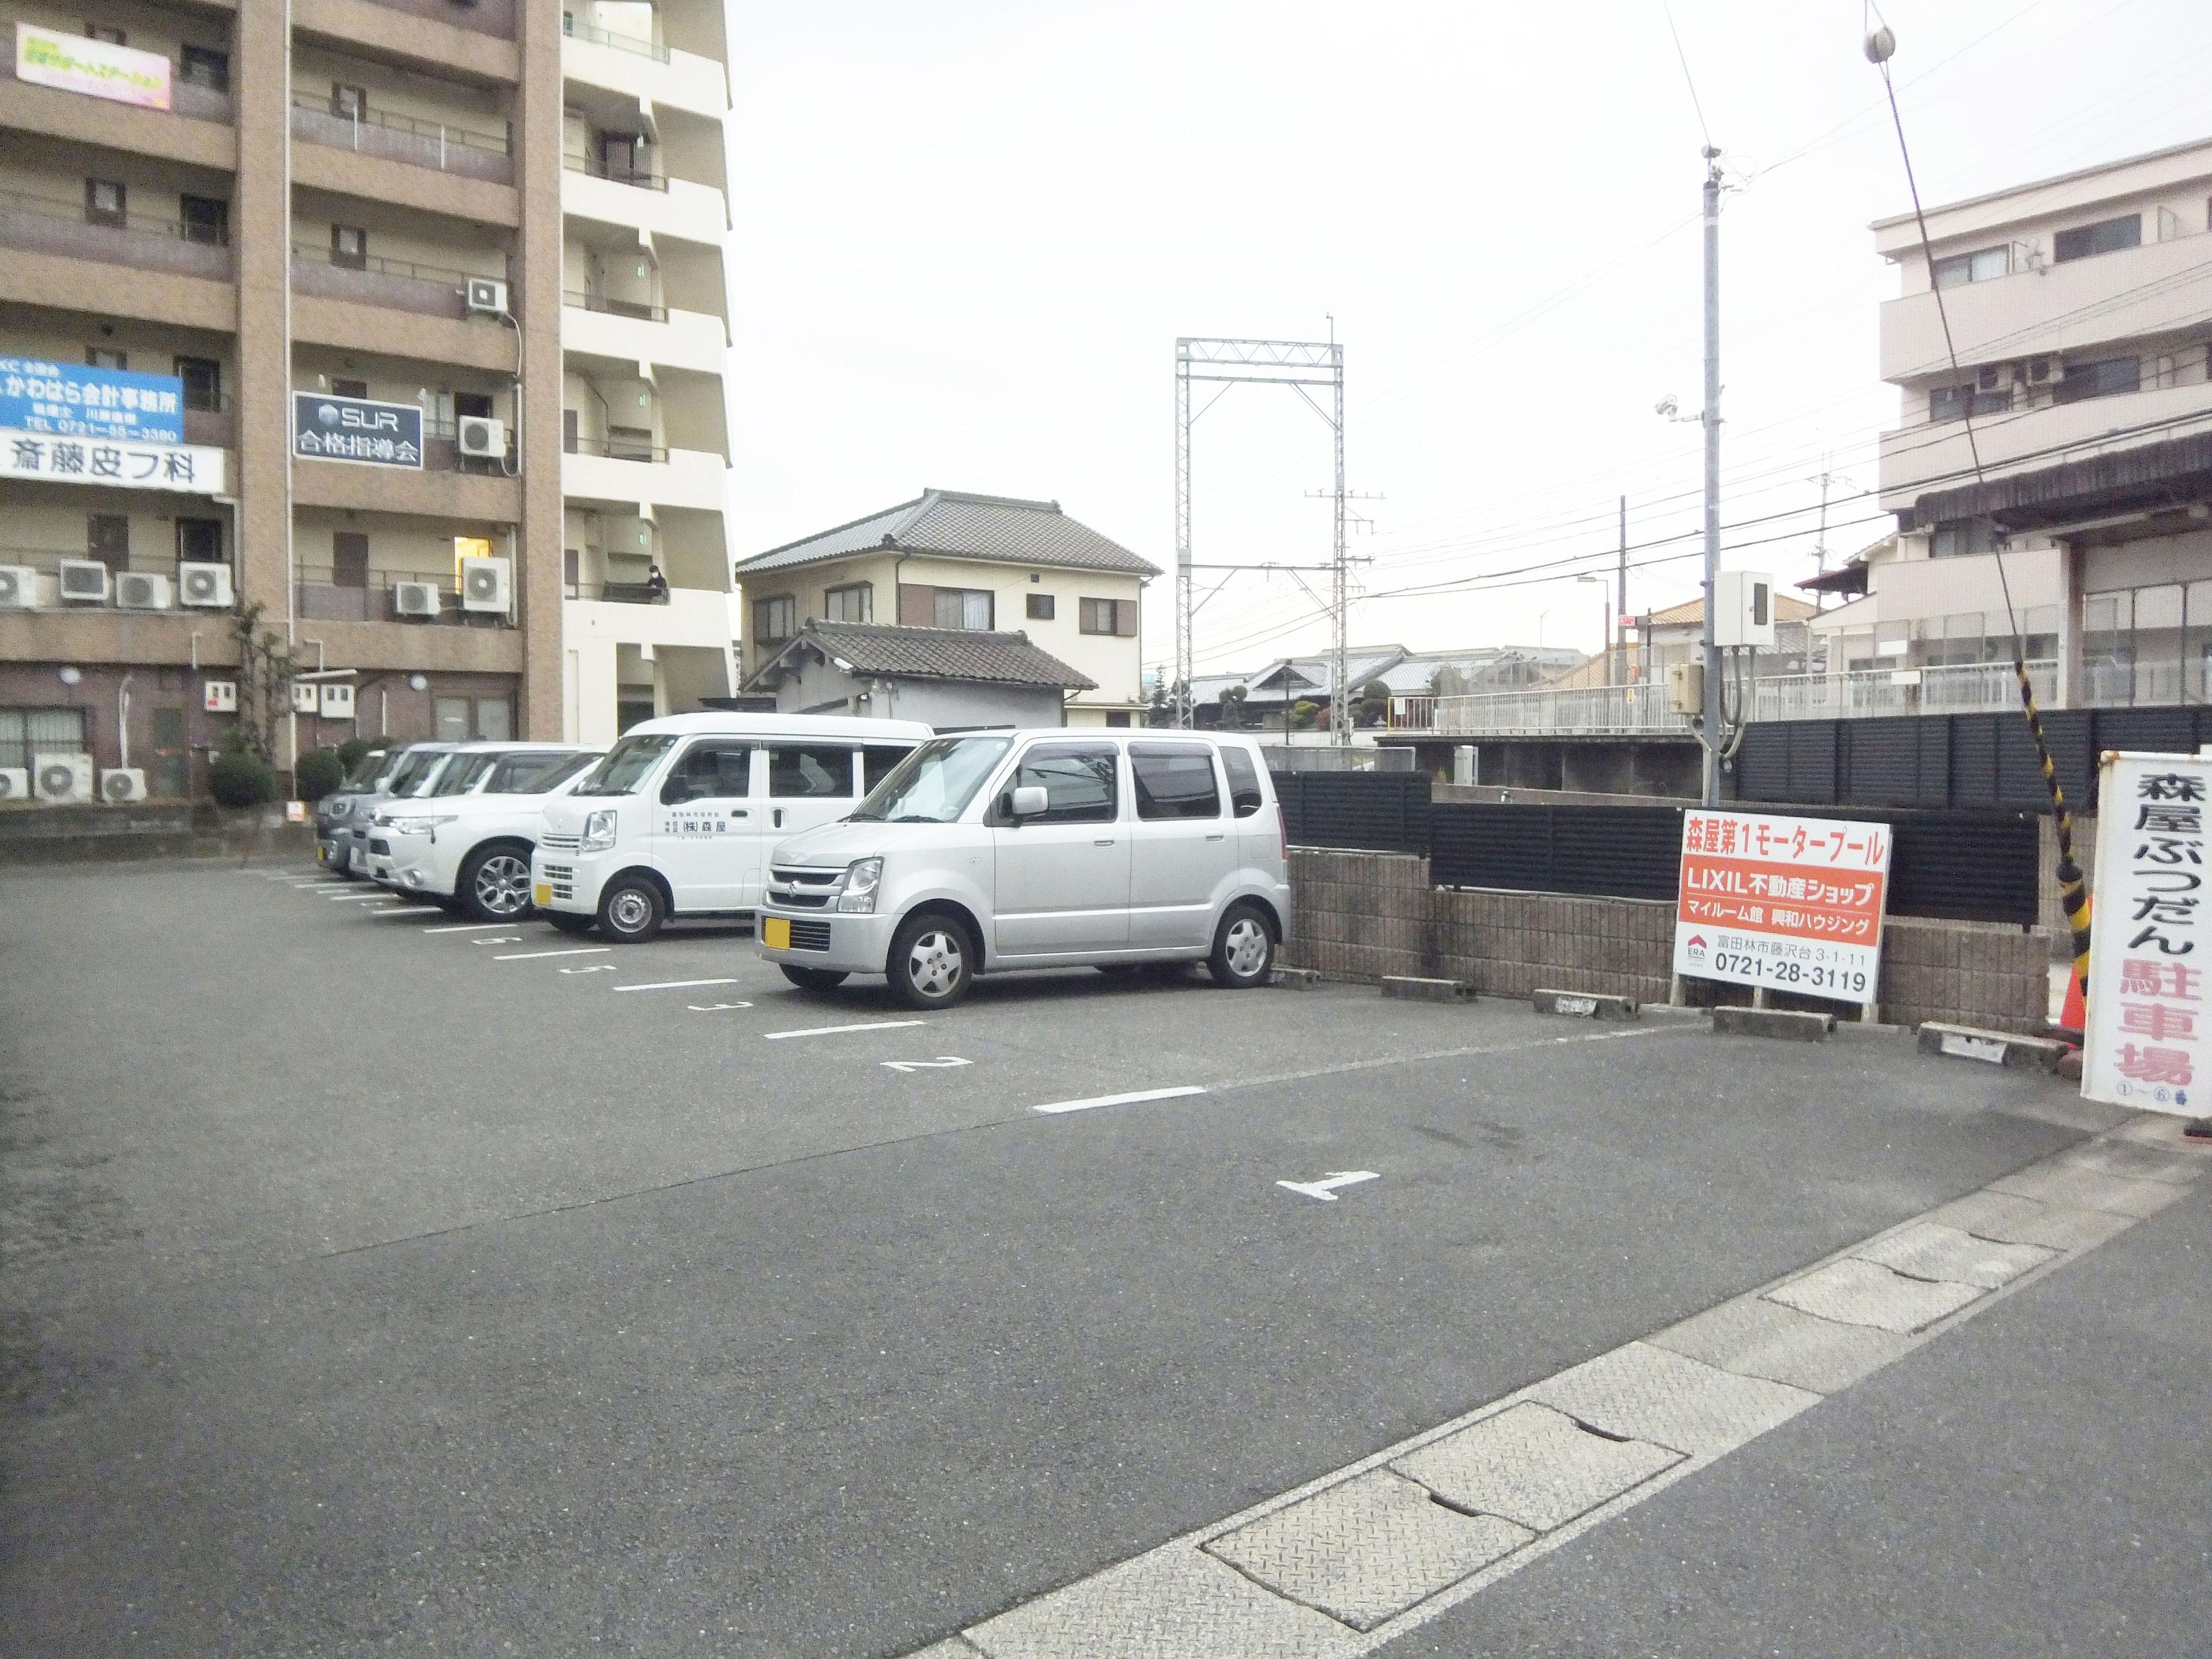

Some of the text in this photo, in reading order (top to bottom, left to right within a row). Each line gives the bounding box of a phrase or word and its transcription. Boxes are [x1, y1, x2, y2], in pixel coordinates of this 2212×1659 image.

[1686, 816, 1884, 865] 森屋第1モータープール
[1687, 867, 1874, 906] LIXIL不動産ショップ
[1687, 899, 1764, 925] マイルーム館
[1688, 948, 1705, 957] ERA
[1715, 952, 1866, 993] 0721-28-3119
[879, 1055, 975, 1073] 2
